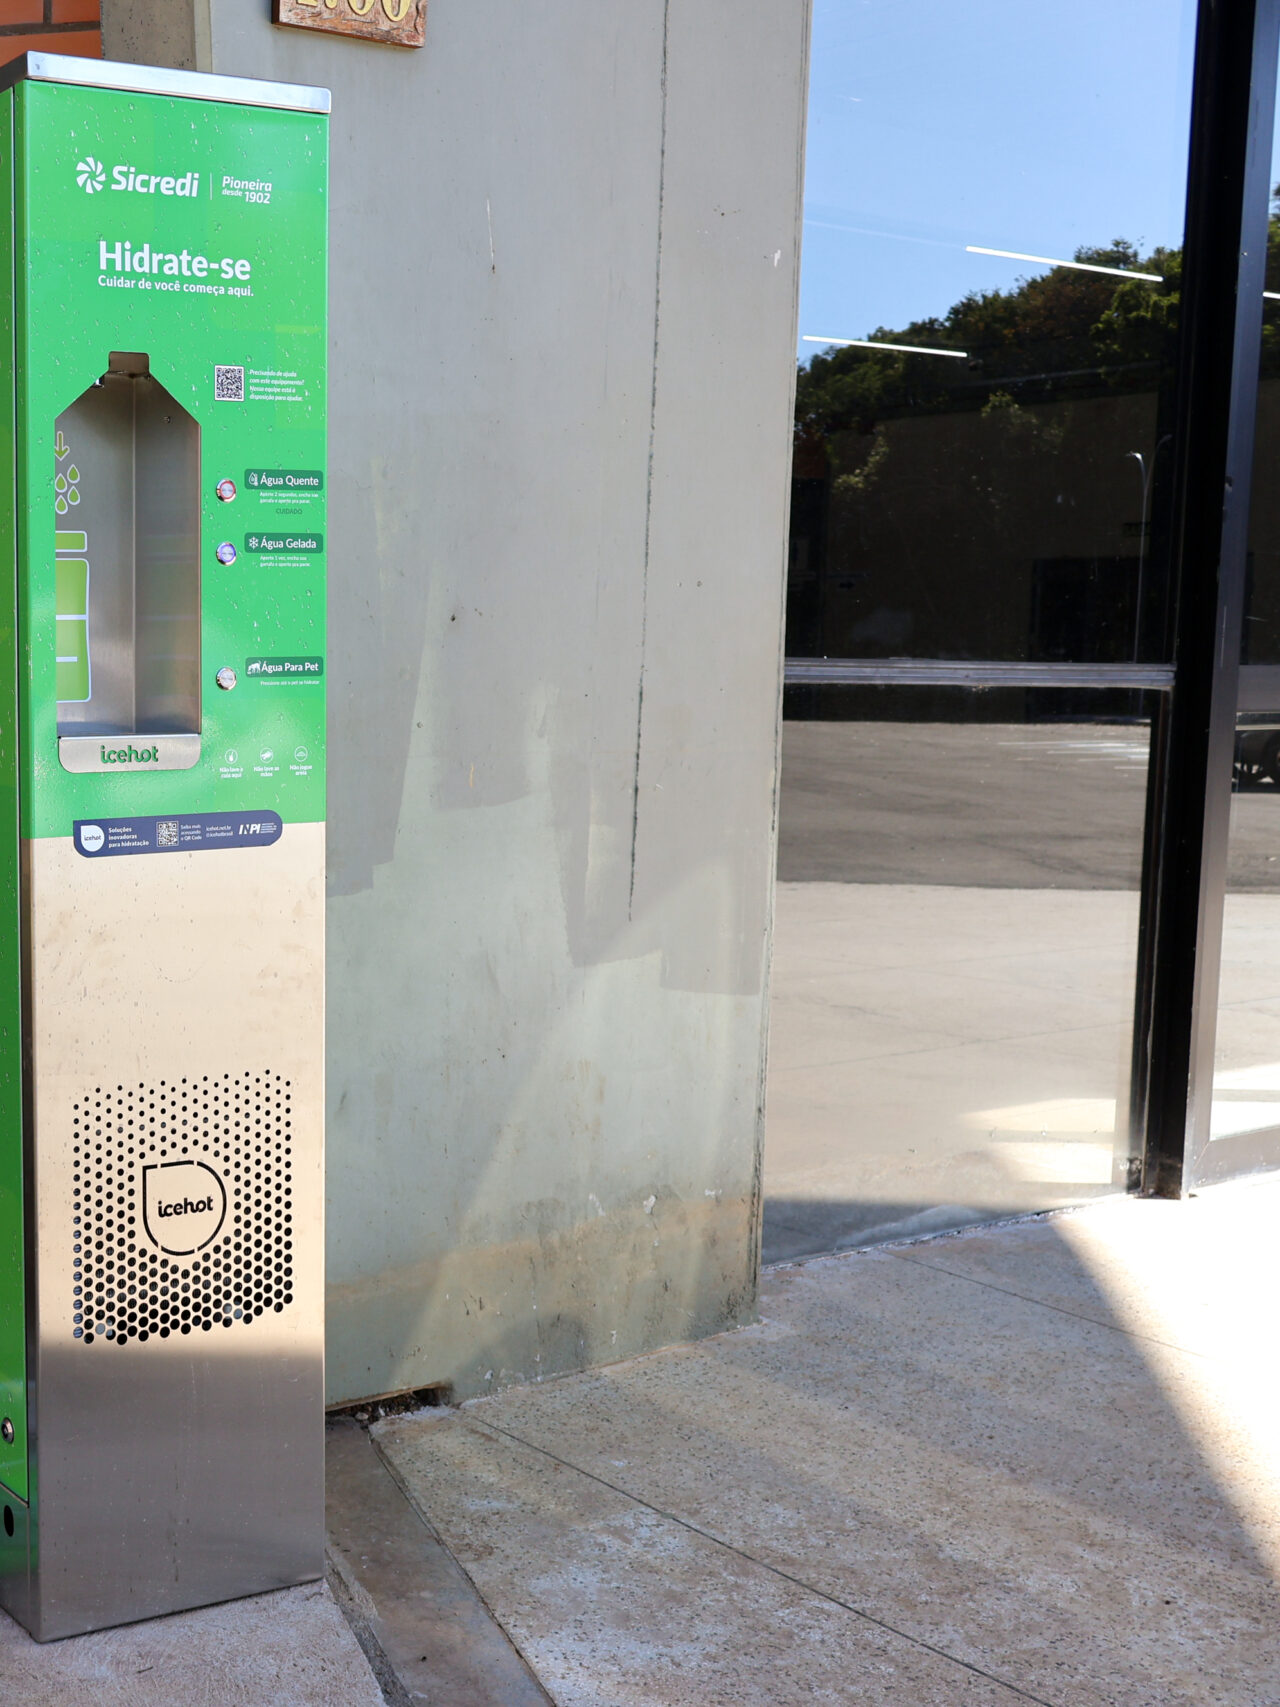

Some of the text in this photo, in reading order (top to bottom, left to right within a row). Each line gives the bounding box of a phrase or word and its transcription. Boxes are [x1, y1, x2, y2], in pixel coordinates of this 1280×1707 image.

[111, 165, 199, 197] Sicredi
[222, 176, 272, 191] Pioneira
[222, 188, 270, 204] desde 1902
[98, 240, 251, 280] Hidrate-se
[98, 275, 254, 298] Cuidar de você começa aqui.
[260, 472, 319, 487] Água Quente
[260, 536, 317, 550] Água Gelada
[261, 661, 319, 673] Água Para Pet
[100, 745, 159, 764] icehot
[158, 1196, 213, 1218] icehot
